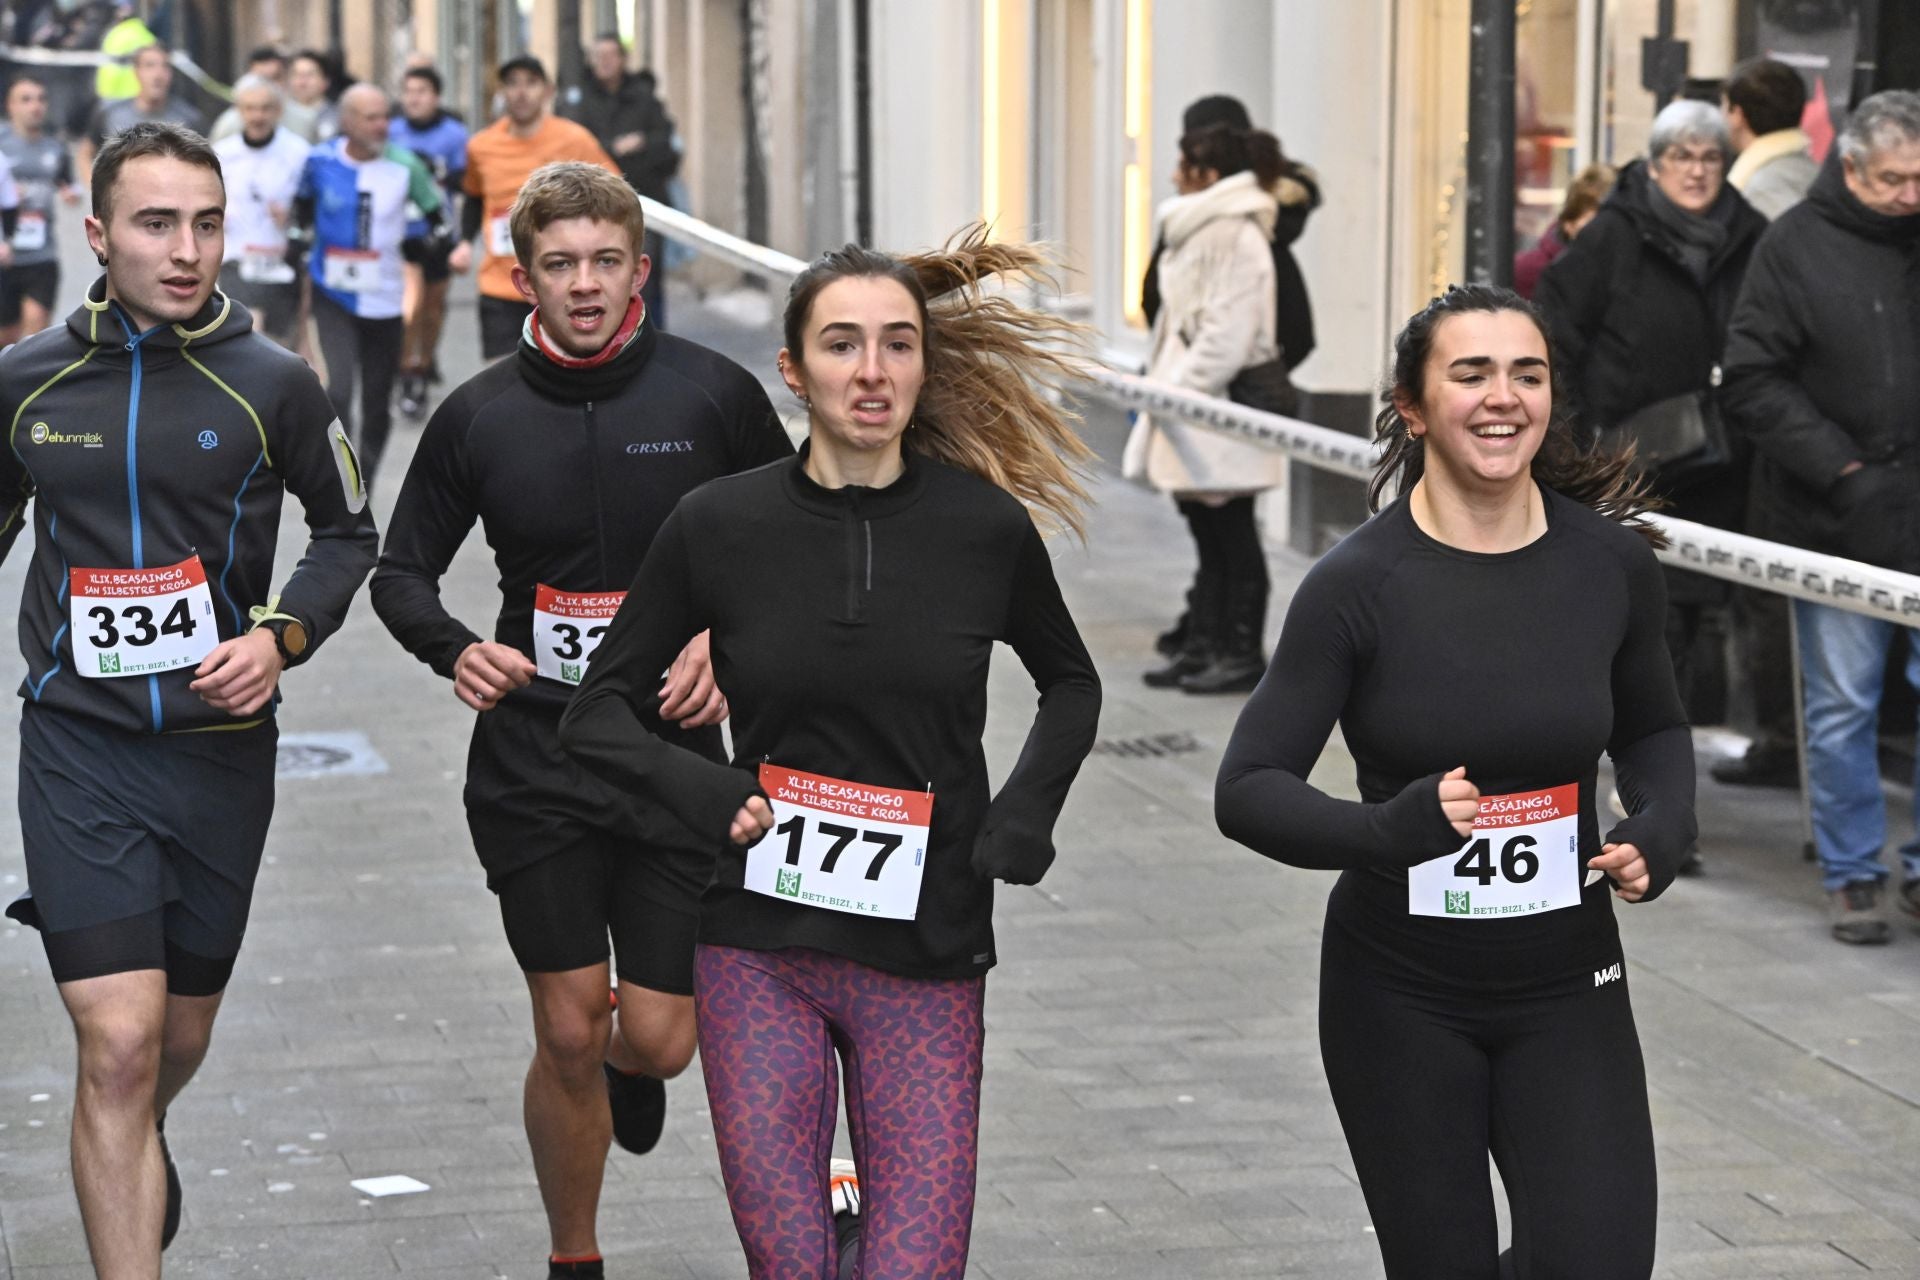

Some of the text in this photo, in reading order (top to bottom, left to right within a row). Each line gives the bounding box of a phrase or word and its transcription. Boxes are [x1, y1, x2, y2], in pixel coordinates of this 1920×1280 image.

[49, 431, 103, 443] ehunmilak
[625, 440, 694, 454] GRSRXX
[84, 578, 192, 595] SAN SILBESTRE KROSA
[548, 604, 620, 617] SAN SILBESTR
[88, 597, 197, 649] 334
[552, 622, 611, 662] 32
[778, 787, 910, 821] SAN SILBESTRE KROSA
[1478, 794, 1552, 813] EASAINGO
[1471, 807, 1560, 826] BESTRE KROSA
[776, 815, 904, 882] 177
[1454, 834, 1539, 886] 46
